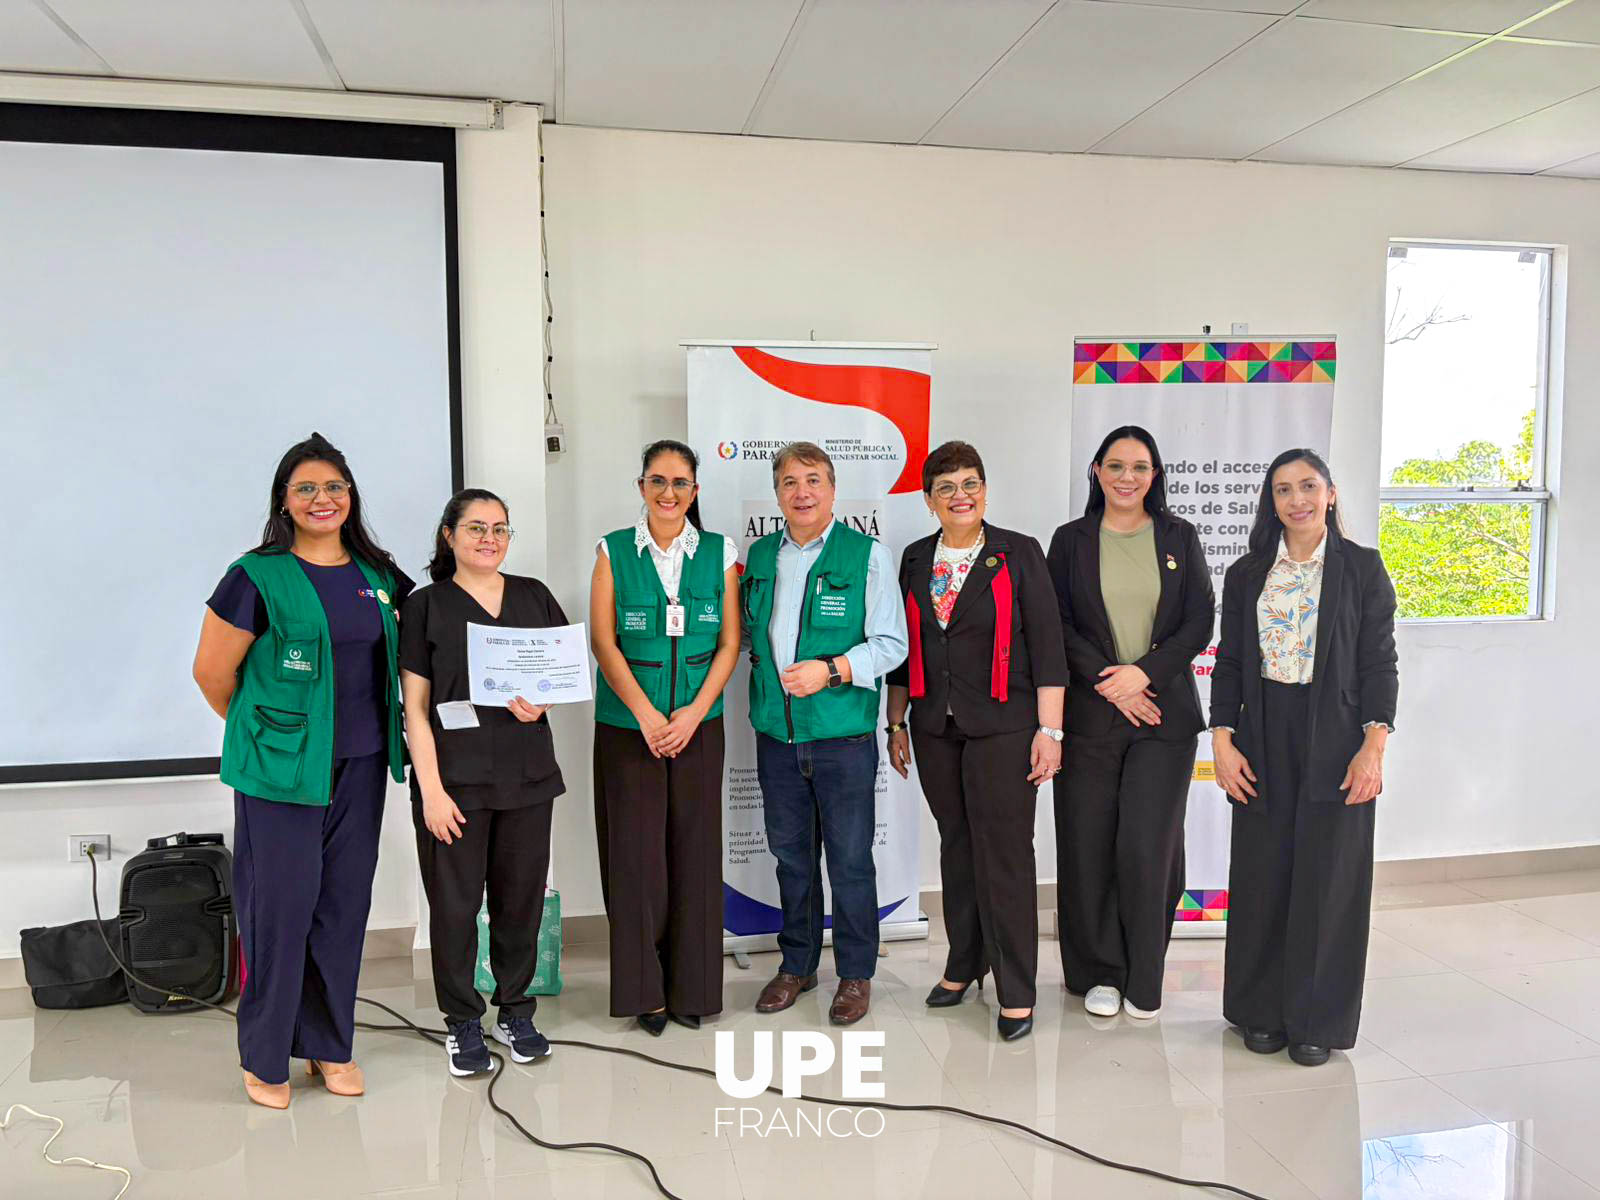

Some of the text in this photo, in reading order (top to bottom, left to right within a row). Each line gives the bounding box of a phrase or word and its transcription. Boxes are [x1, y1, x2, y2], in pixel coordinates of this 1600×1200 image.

[1202, 460, 1218, 474] el
[1168, 481, 1190, 494] de
[1195, 481, 1220, 494] los
[1201, 501, 1223, 515] de
[745, 516, 787, 537] ALT
[1218, 524, 1249, 535] con
[729, 838, 764, 848] prioridad
[729, 848, 767, 857] Programas
